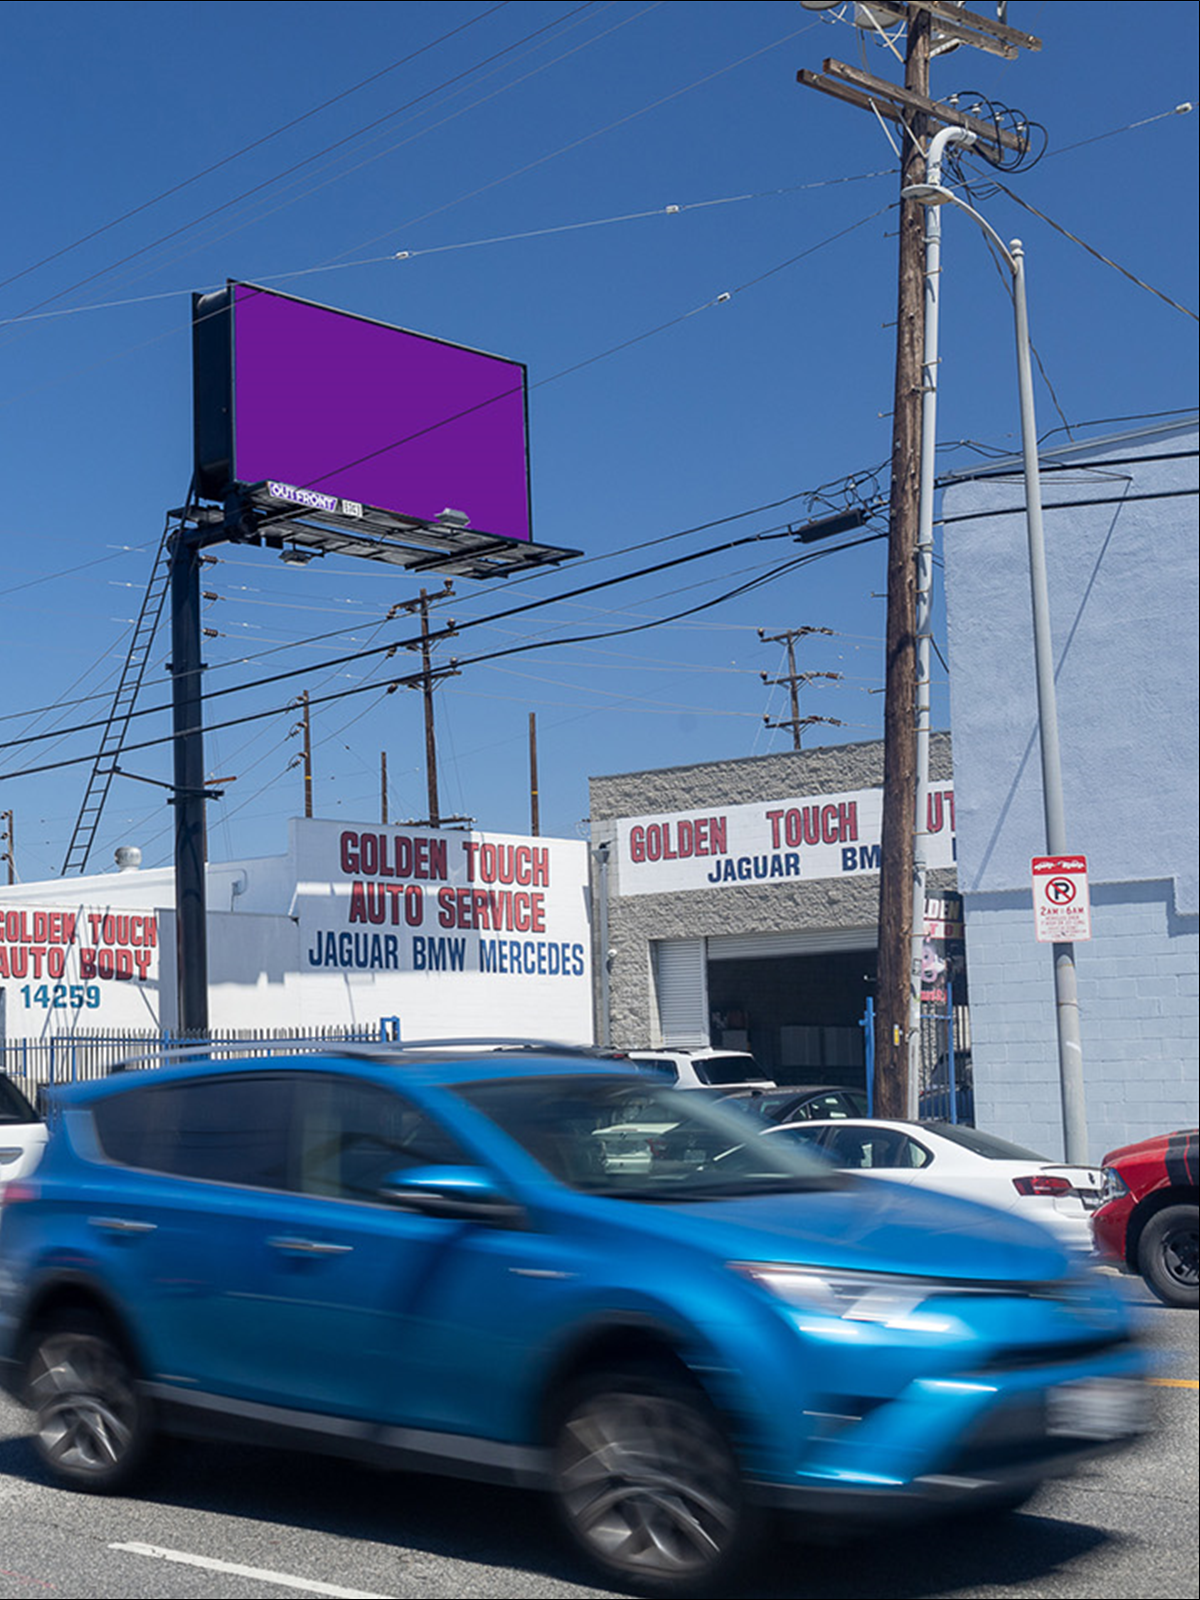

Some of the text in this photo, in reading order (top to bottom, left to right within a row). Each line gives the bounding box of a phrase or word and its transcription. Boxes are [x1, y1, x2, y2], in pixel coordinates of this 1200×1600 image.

[270, 482, 337, 512] OUTFRONT
[629, 817, 727, 863] GOLDEN
[766, 801, 858, 849] TOUCH
[340, 831, 550, 887] GOLDEN TOUCH
[707, 845, 881, 883] JAGUAR BM
[349, 881, 546, 933] AUTO SERVICE
[88, 913, 157, 948] TOUCH
[79, 947, 151, 982] BODY
[309, 930, 585, 976] JAGUAR BMW MERCEDES
[20, 984, 101, 1009] 14259
